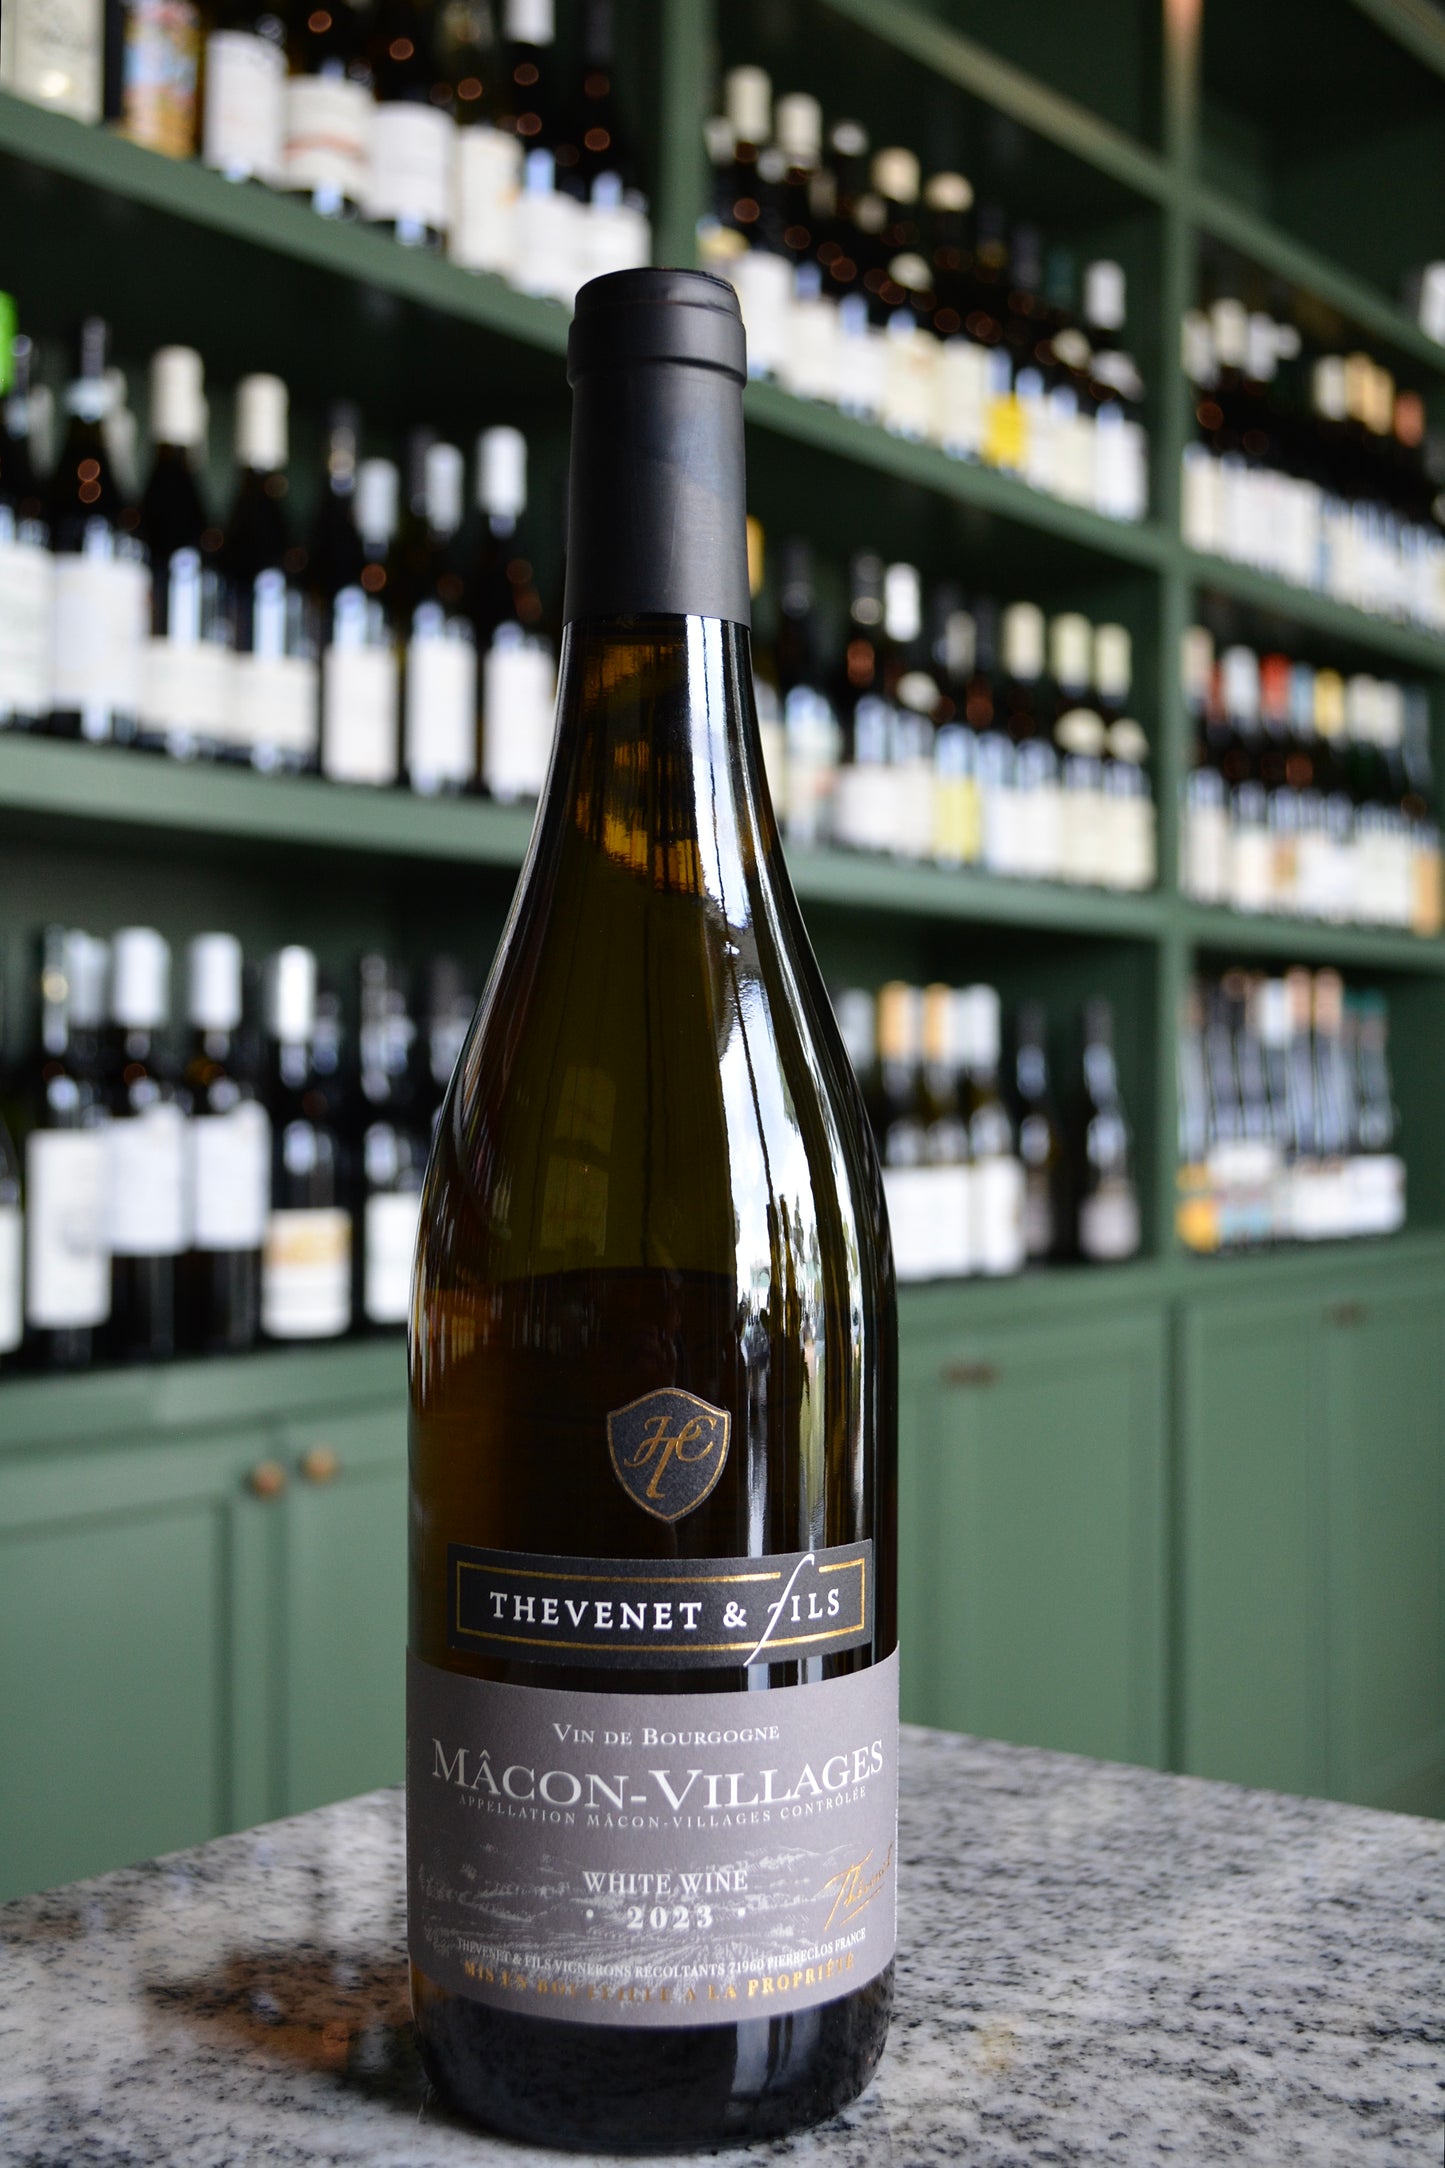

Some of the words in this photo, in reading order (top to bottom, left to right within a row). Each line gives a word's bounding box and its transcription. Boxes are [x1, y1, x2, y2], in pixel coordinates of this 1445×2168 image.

[489, 1590, 702, 1631] THEVENET
[722, 1601, 747, 1628] &
[553, 1723, 595, 1743] VIN
[603, 1730, 632, 1745] DE
[642, 1726, 780, 1746] BOURGOGNE
[432, 1738, 884, 1811] MÂCON-VILLAGES
[458, 1793, 577, 1825] APPELLATION
[586, 1809, 771, 1829] MÂCON-VILLAGES
[780, 1786, 867, 1820] CONTRÔLÉE
[583, 1871, 671, 1895] WHITE
[679, 1870, 748, 1895] WINE
[626, 1905, 713, 1930] 2023
[512, 1953, 522, 1965] &
[525, 1954, 551, 1970] FILS
[554, 1959, 632, 1978] VIGNERONS
[634, 1962, 725, 1979] RÉCOLTANTS
[728, 1958, 765, 1975] 71960
[766, 1942, 834, 1969] PIERRECLOS
[834, 1927, 866, 1952] FRANCE
[464, 1959, 495, 1984] MIS
[707, 1983, 738, 2001] LA
